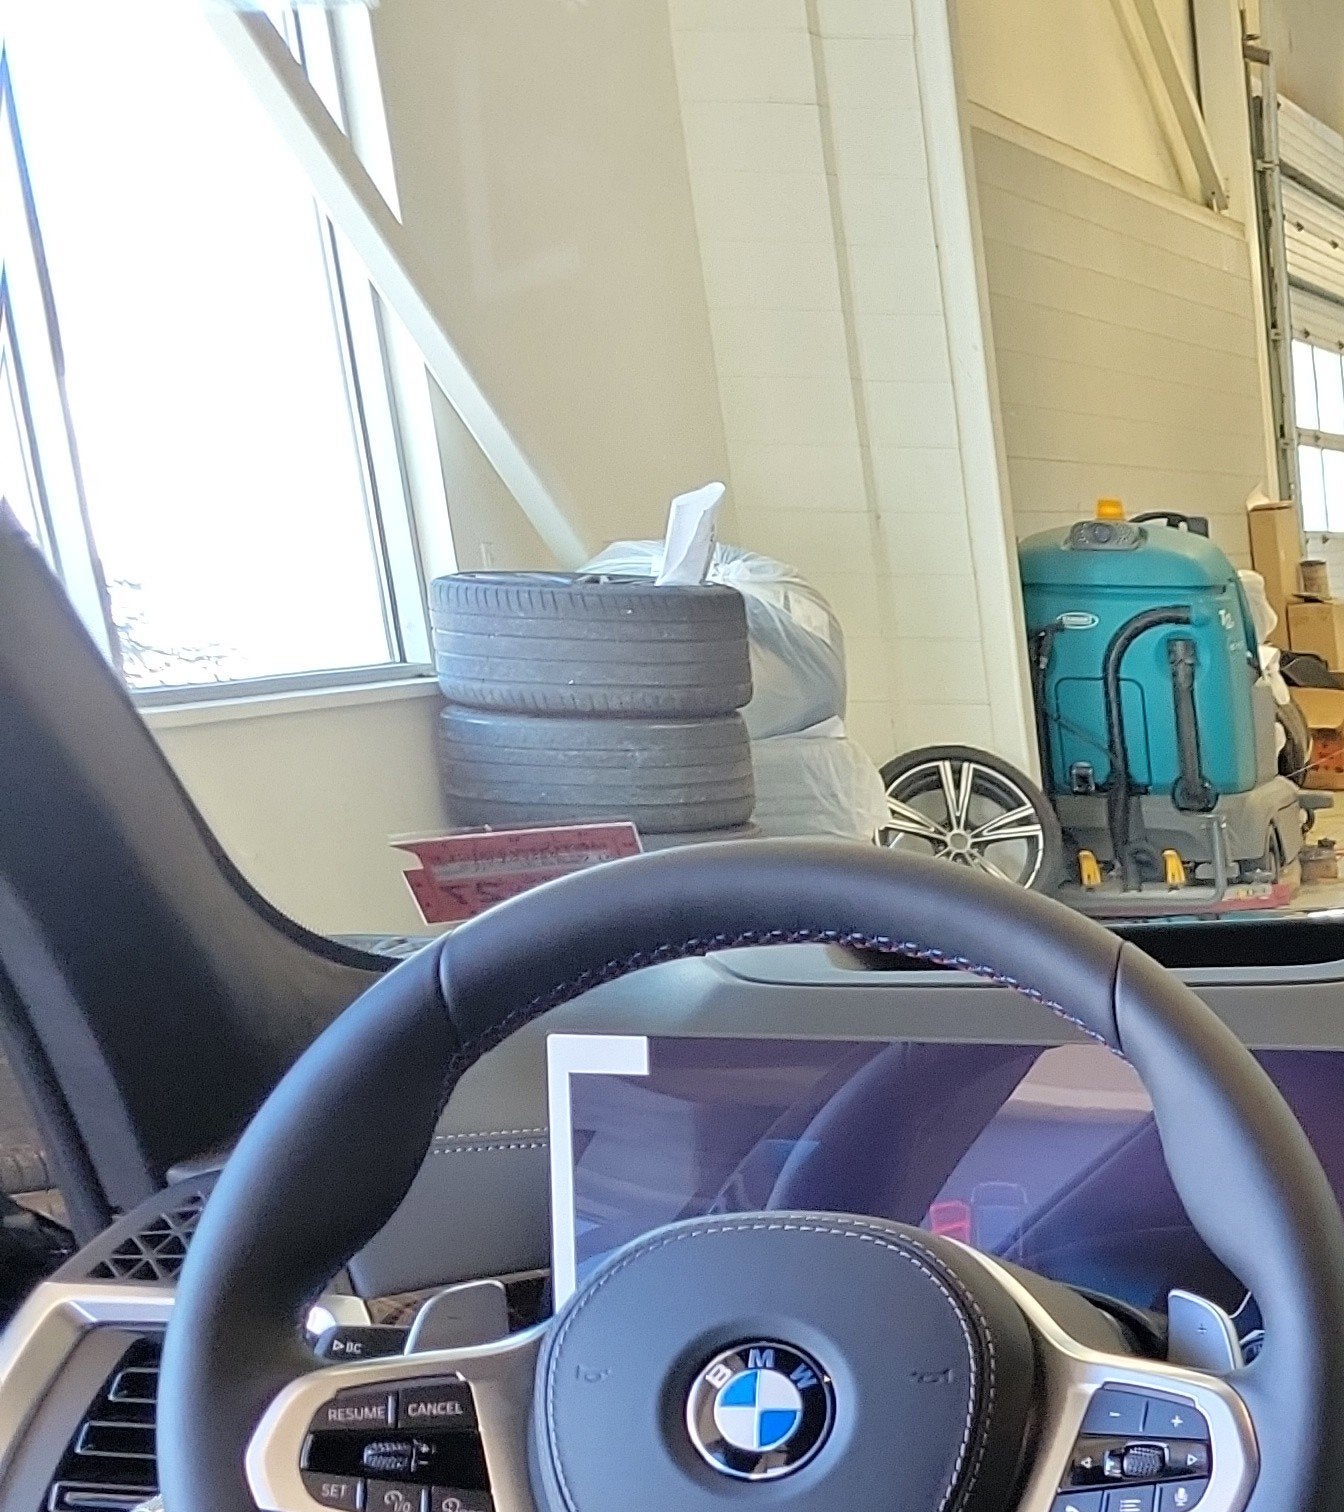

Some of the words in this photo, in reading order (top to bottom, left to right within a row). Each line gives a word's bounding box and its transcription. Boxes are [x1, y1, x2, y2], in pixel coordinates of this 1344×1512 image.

[705, 1348, 818, 1391] BMW
[328, 1406, 386, 1421] RESUME
[407, 1402, 463, 1417] CANCEL
[321, 1484, 348, 1498] SET
